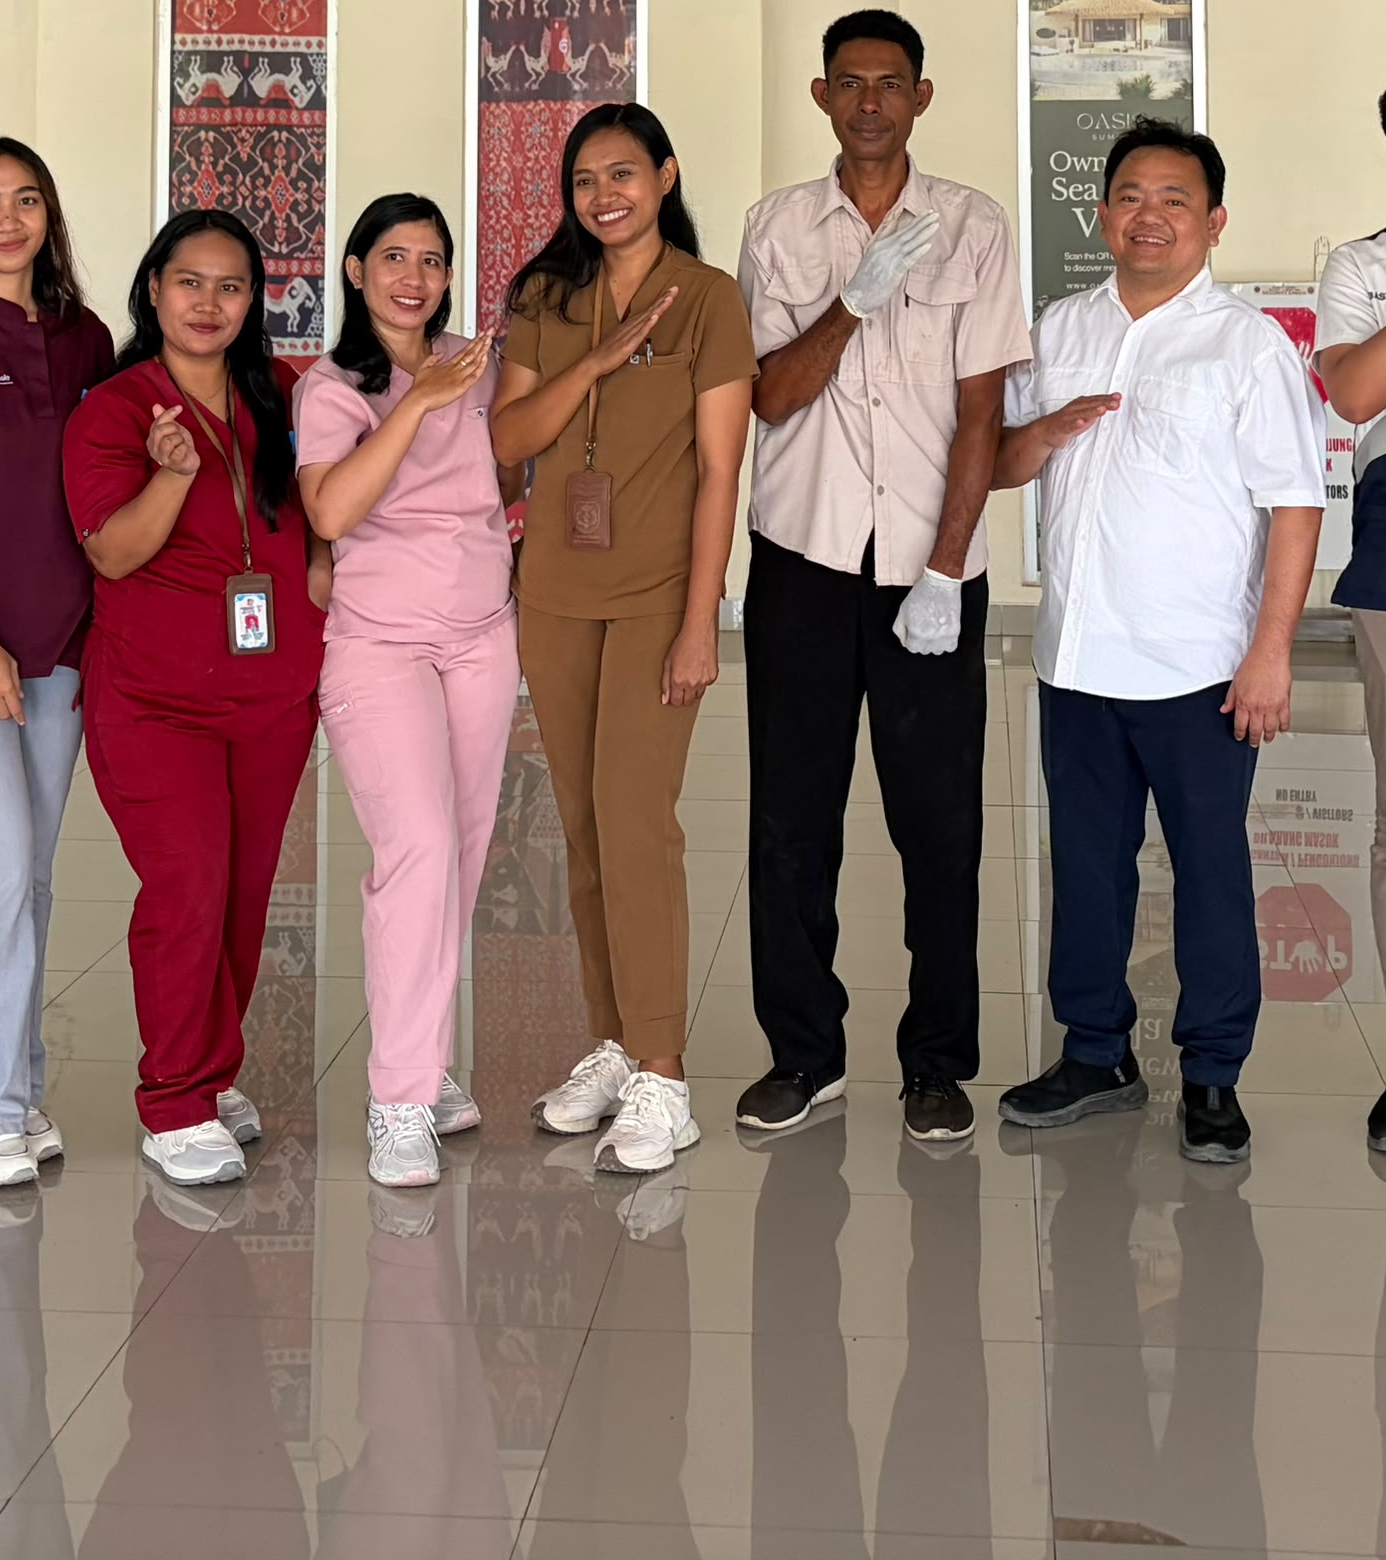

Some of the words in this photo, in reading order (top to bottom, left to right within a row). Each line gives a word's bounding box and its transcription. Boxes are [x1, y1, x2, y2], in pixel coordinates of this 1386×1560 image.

[1077, 113, 1136, 130] OASI
[1051, 176, 1100, 201] Sea
[1064, 252, 1082, 261] Scan
[1083, 252, 1096, 260] the
[1097, 252, 1110, 261] QR
[1072, 264, 1102, 272] discover
